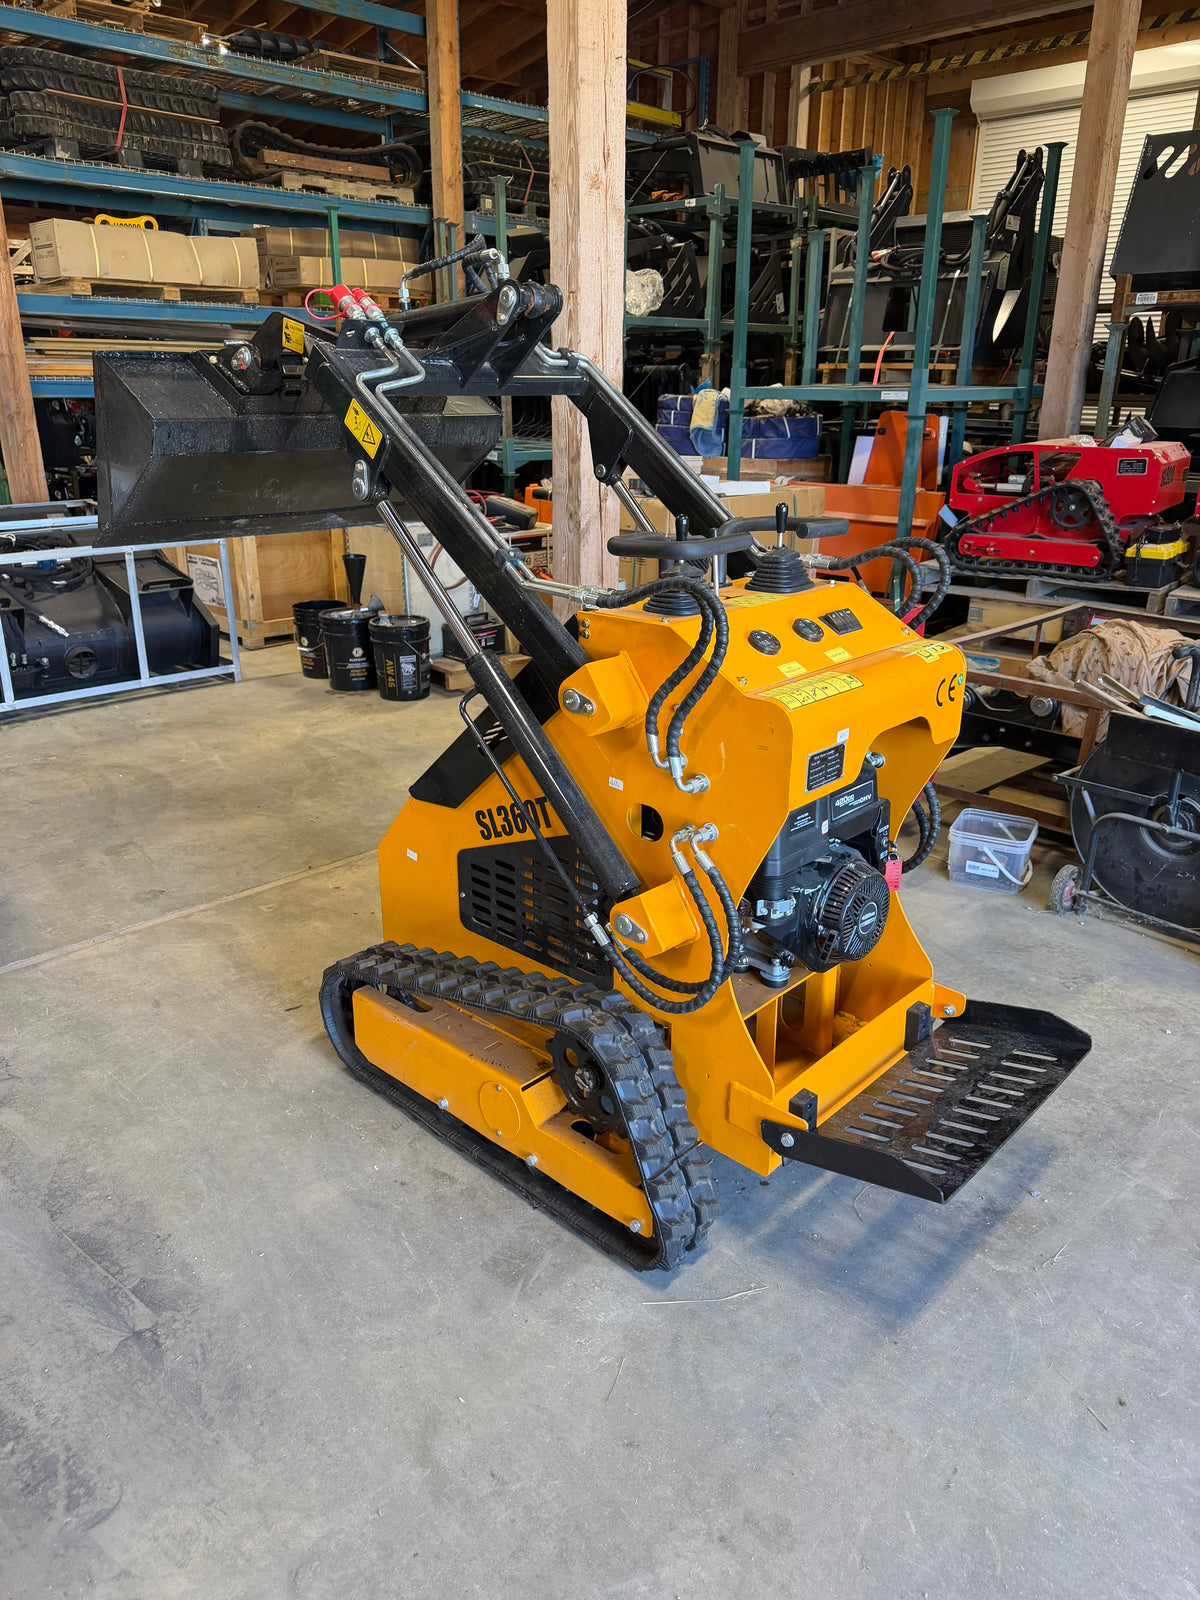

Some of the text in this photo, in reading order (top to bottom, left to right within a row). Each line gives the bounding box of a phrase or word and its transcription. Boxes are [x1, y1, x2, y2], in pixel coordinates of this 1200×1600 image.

[385, 659, 396, 688] AW 46
[936, 672, 958, 707] CE
[834, 793, 855, 807] 420cc
[474, 796, 552, 840] SL360T
